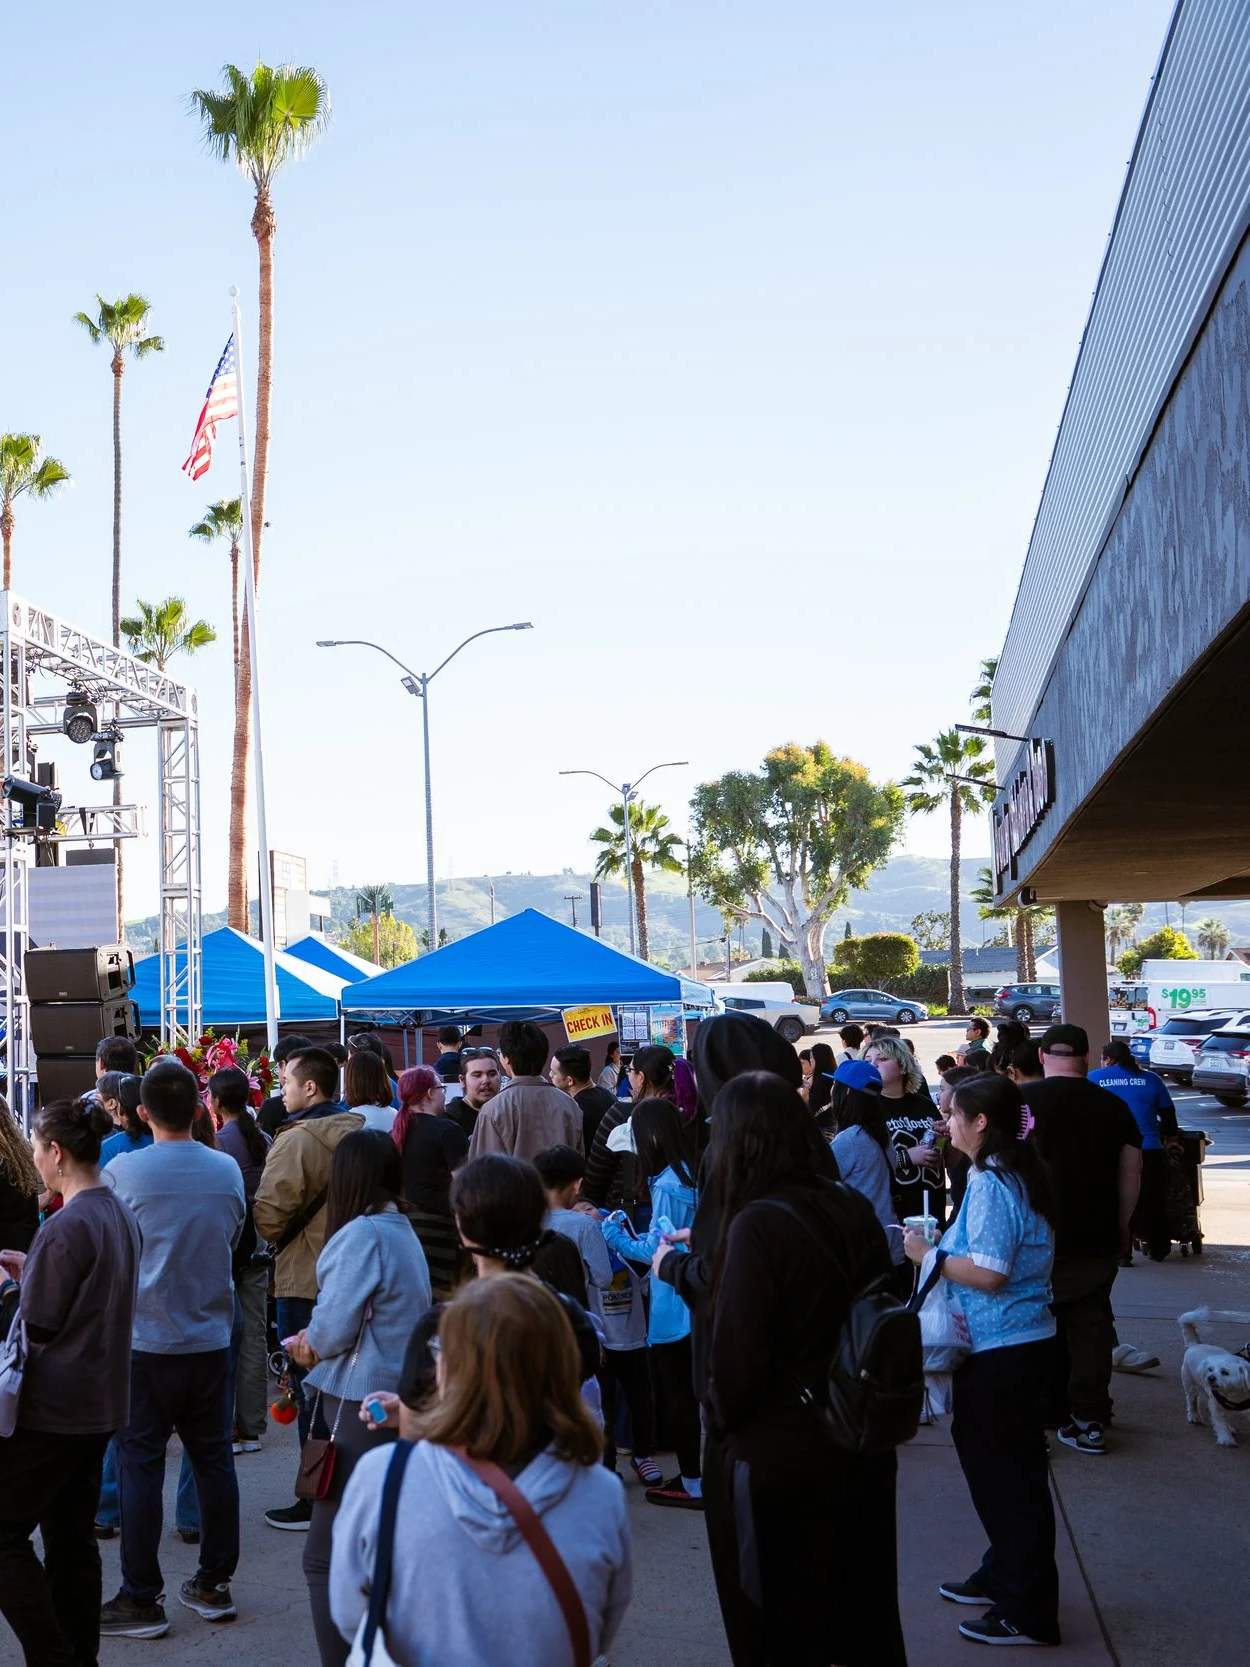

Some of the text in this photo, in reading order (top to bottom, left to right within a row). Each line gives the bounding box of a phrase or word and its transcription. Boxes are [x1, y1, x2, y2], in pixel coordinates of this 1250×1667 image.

[567, 1013, 613, 1034] CHECK IN
[1099, 1078, 1146, 1087] CLEANING CREW
